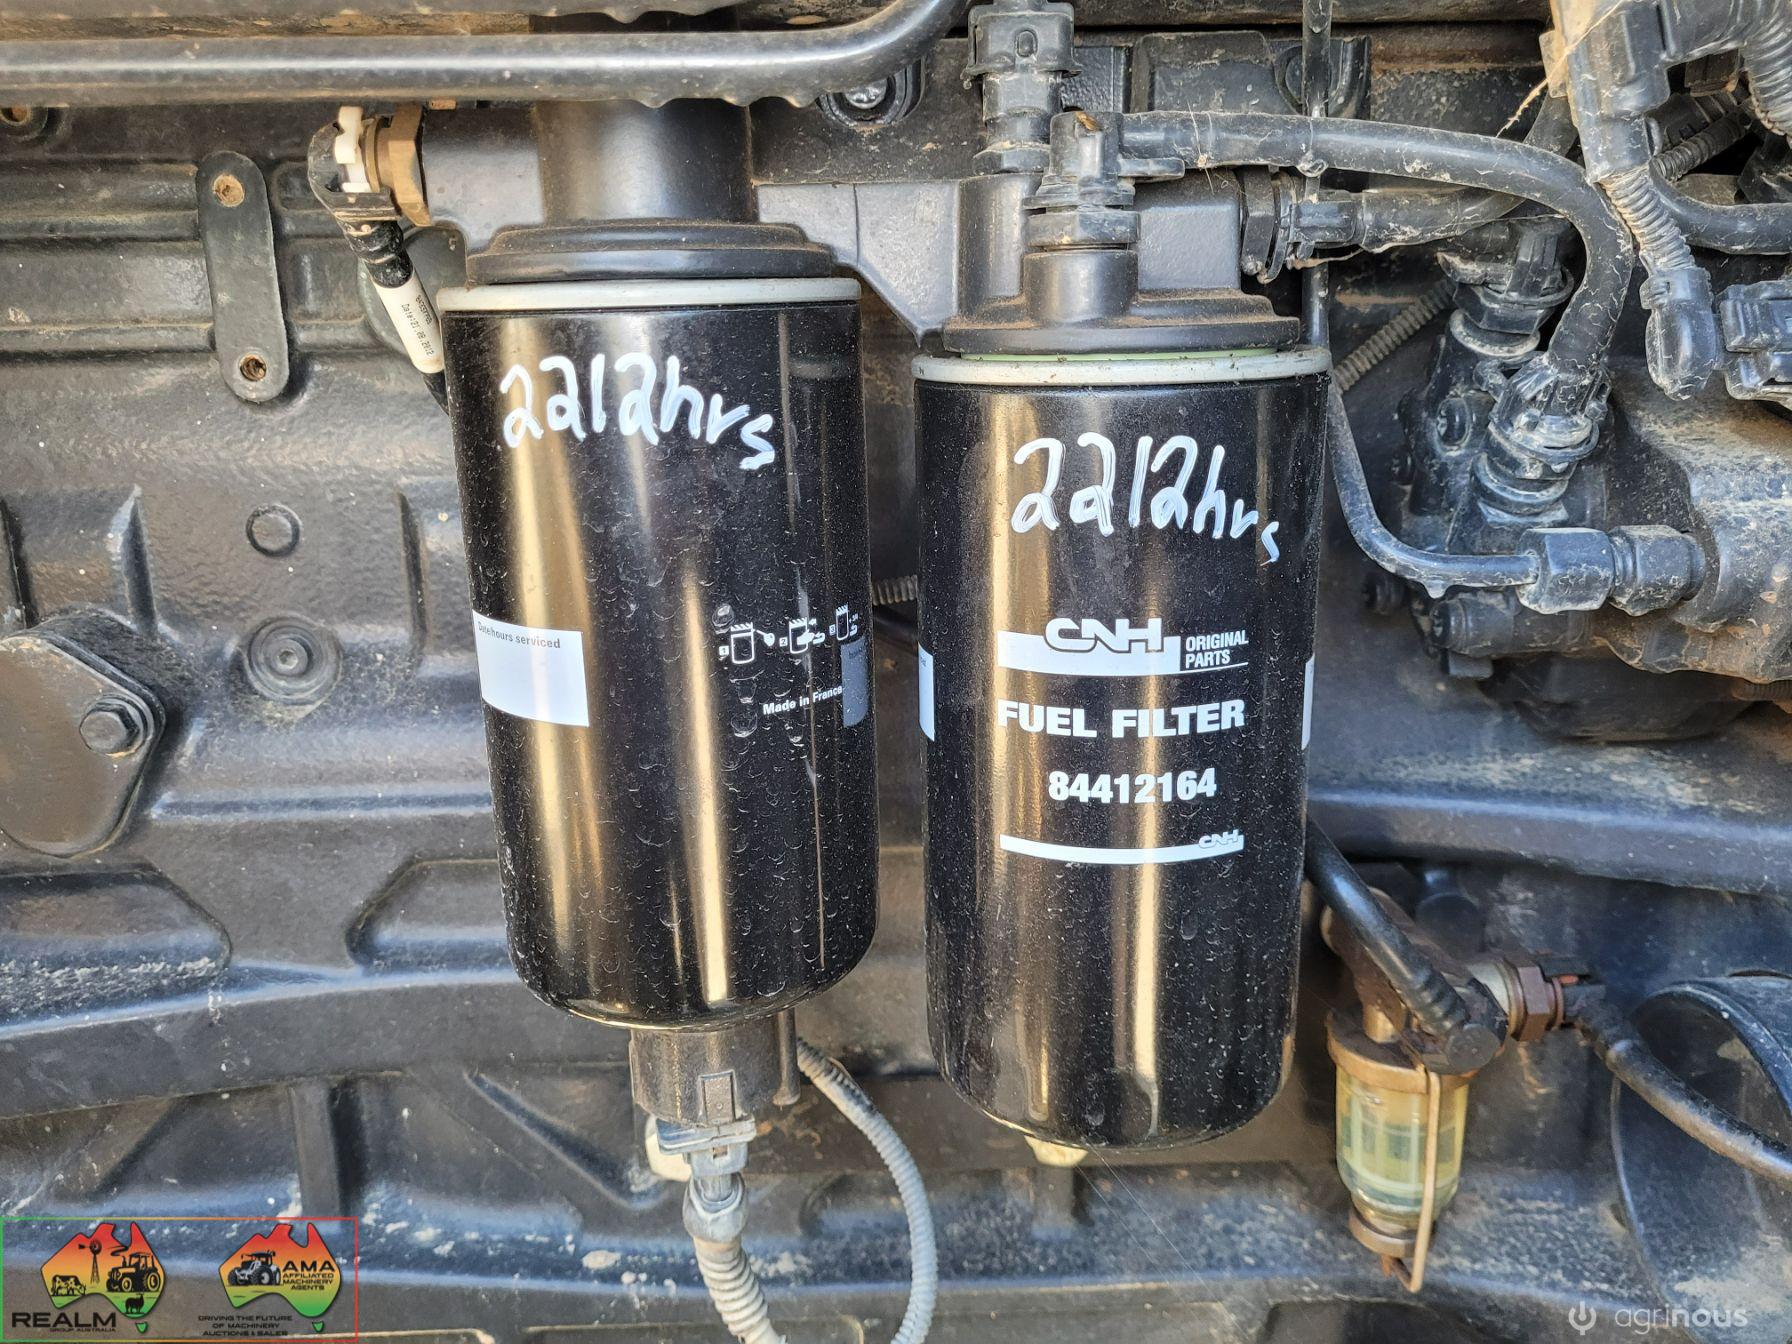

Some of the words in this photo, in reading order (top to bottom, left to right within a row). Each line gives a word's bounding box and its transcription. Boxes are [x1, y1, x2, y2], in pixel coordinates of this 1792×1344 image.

[499, 352, 776, 470] 2212hrs
[1011, 432, 1280, 566] 2212hrs
[515, 635, 561, 648] serviced
[1045, 617, 1163, 652] CNH
[1185, 630, 1249, 652] ORIGINAL
[1185, 649, 1231, 669] PARTS
[762, 701, 797, 715] Made
[799, 696, 810, 707] in
[812, 685, 843, 703] France
[997, 699, 1098, 738] FUEL
[1111, 699, 1245, 738] FILTER
[1048, 767, 1217, 804] 84412164
[1198, 829, 1240, 848] CNH
